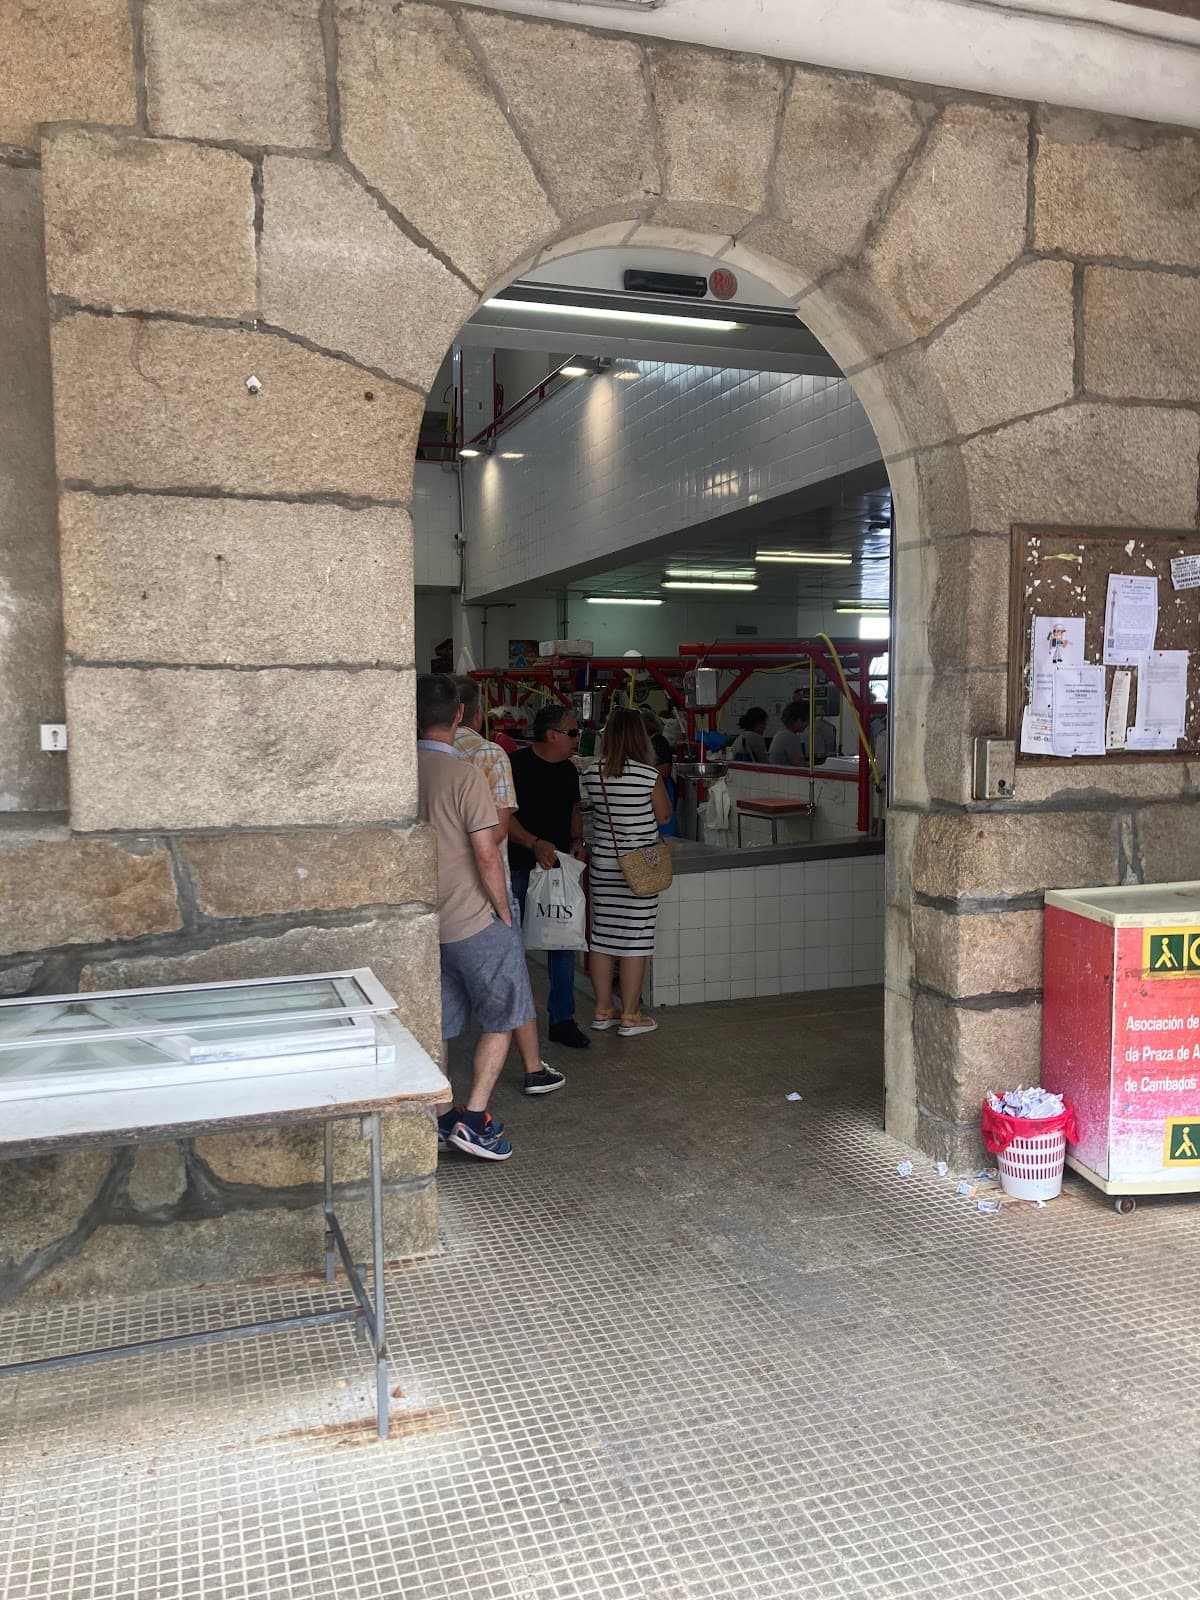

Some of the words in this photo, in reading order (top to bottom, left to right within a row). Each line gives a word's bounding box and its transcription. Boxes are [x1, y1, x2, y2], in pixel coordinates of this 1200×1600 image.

[536, 903, 573, 919] MTS
[1126, 1014, 1184, 1031] Asociación
[1187, 1013, 1200, 1029] de
[1125, 1045, 1139, 1062] da
[1142, 1046, 1174, 1061] Praza
[1177, 1044, 1190, 1060] de
[1124, 1075, 1138, 1092] de
[1141, 1075, 1197, 1093] Cambados
